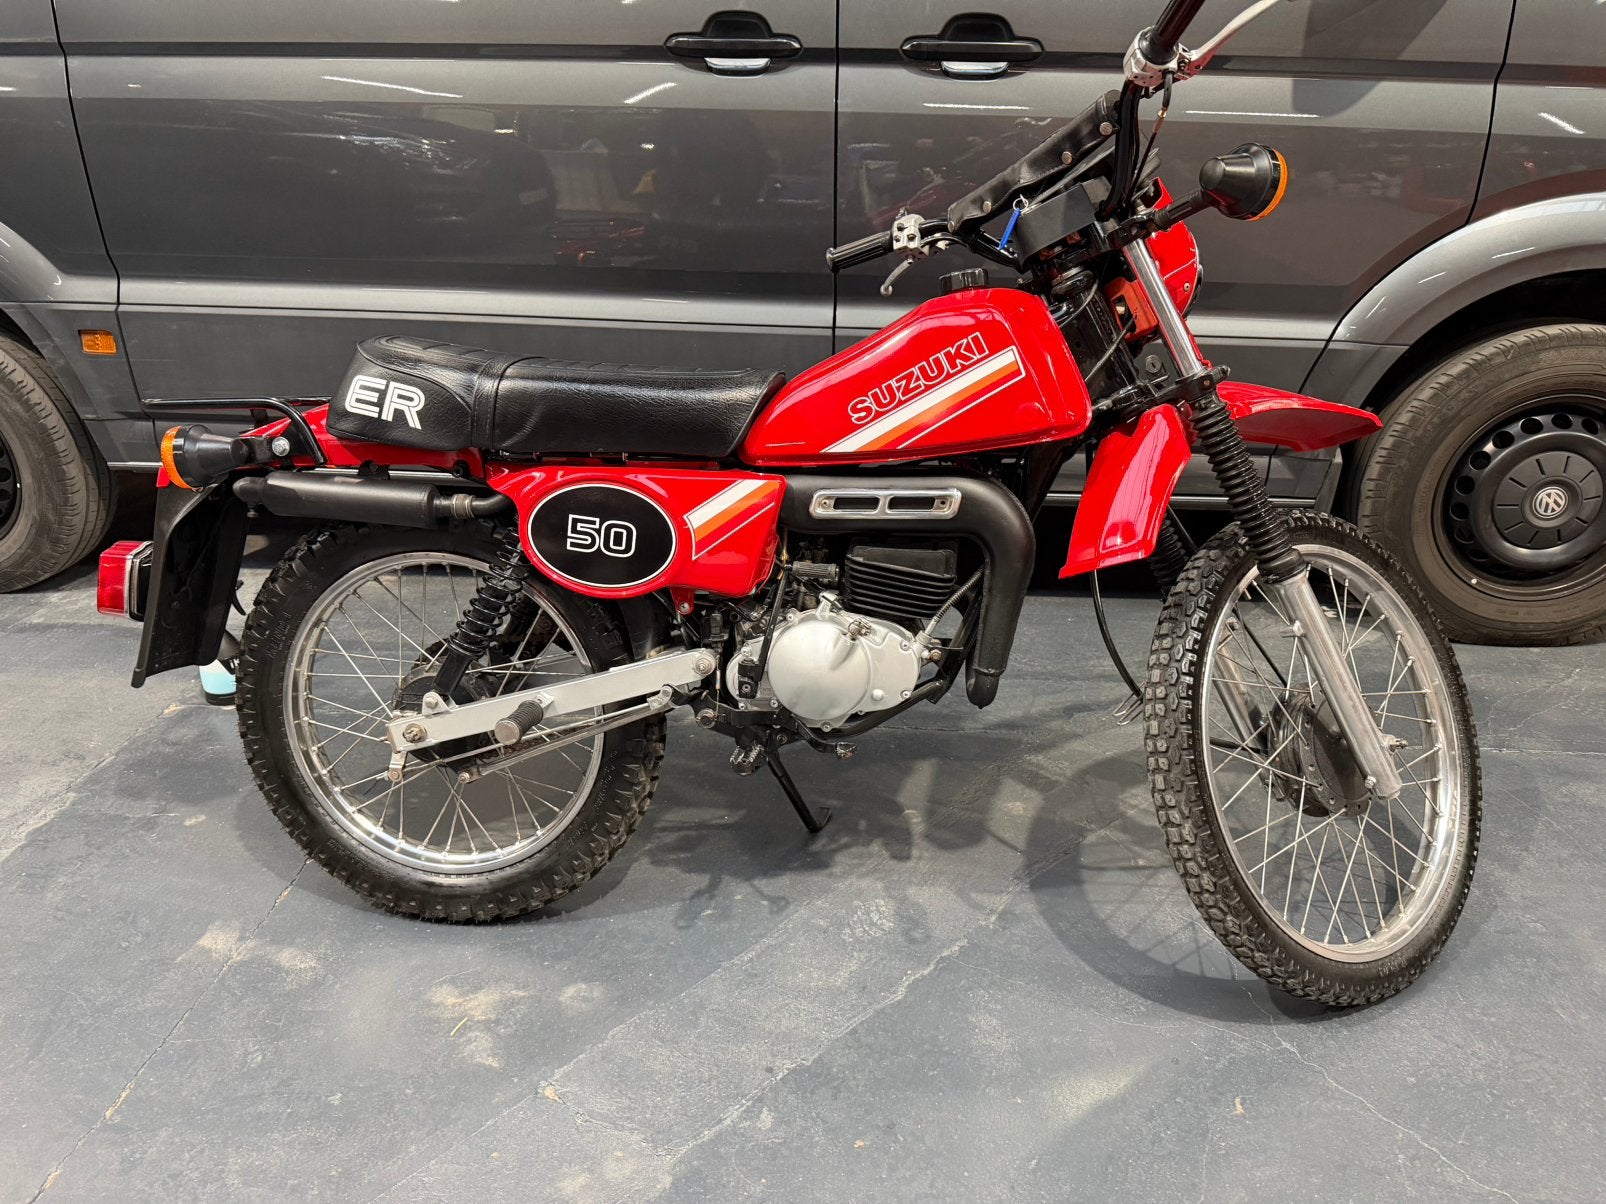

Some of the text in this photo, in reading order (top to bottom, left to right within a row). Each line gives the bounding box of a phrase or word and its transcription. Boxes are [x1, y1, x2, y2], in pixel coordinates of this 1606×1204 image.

[345, 375, 426, 430] ER
[848, 331, 989, 424] SUZUKI
[567, 514, 637, 558] 50
